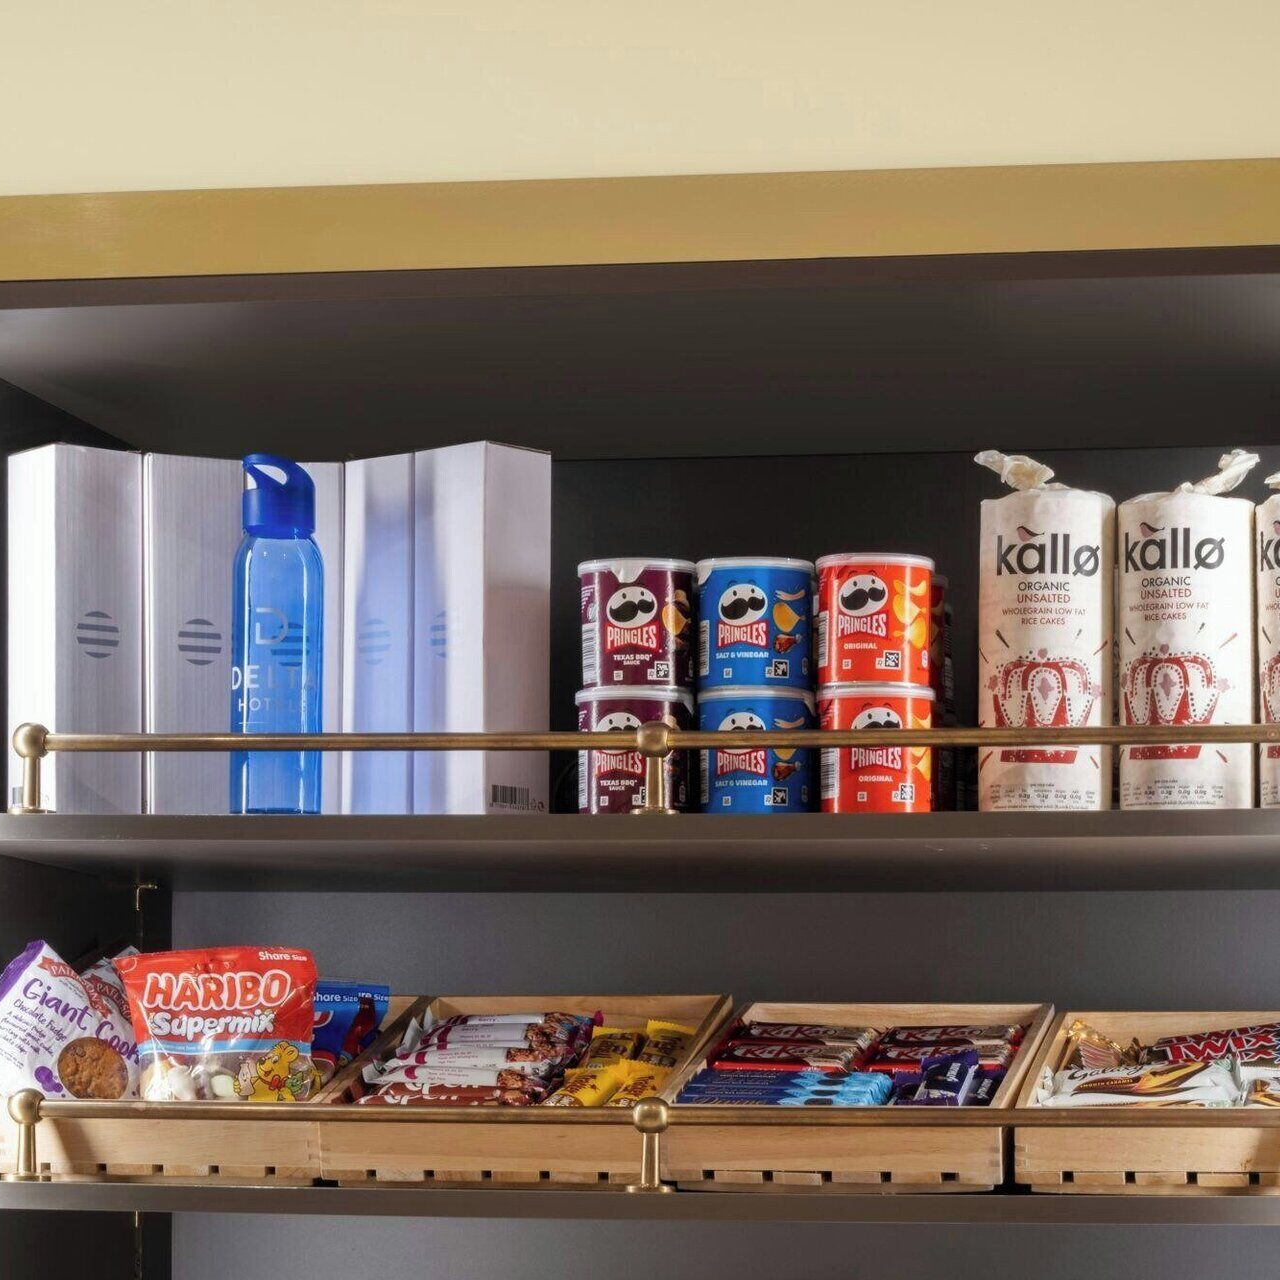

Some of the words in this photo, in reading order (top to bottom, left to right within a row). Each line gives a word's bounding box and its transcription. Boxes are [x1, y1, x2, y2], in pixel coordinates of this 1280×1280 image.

[1018, 581, 1070, 592] ORGANIC
[1141, 576, 1191, 587] ORGANIC
[1017, 594, 1070, 603] UNSALTED
[1141, 588, 1191, 599] UNSALTED
[1002, 607, 1052, 615] WHOLEGRAIN
[1022, 617, 1037, 625] RICE
[1161, 612, 1187, 621] CAKES
[608, 623, 656, 649] PRINGLES
[718, 623, 767, 647] PRINGLES
[838, 614, 887, 637] PRINGLES
[718, 750, 765, 774] PRINGLES
[851, 747, 901, 770] PRINGLES
[259, 951, 290, 961] Share
[143, 970, 292, 1010] HARIBO
[22, 978, 92, 1031] Giant
[13, 1000, 46, 1023] Chocolate
[46, 1020, 67, 1041] Fudge
[152, 1010, 275, 1041] Supermix
